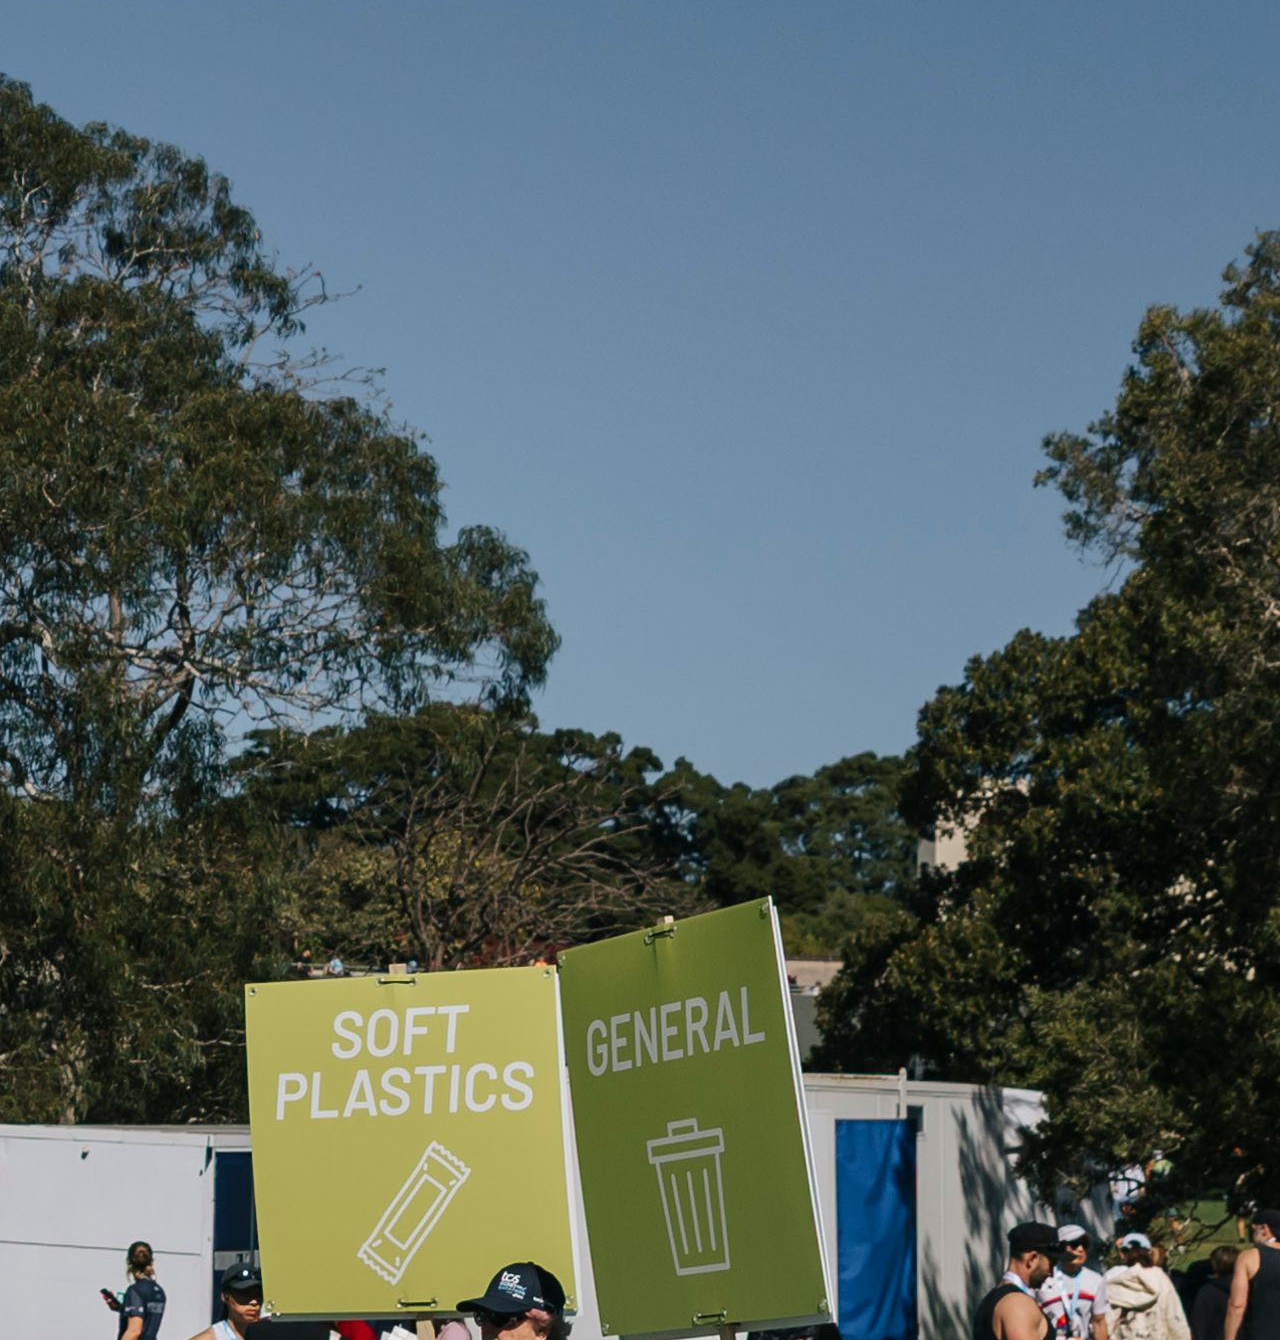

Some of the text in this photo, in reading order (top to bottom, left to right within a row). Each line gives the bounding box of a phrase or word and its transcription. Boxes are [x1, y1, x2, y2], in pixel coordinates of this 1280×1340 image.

[331, 1004, 470, 1059] SOFT
[587, 986, 766, 1077] GENERAL
[276, 1061, 535, 1121] PLASTICS
